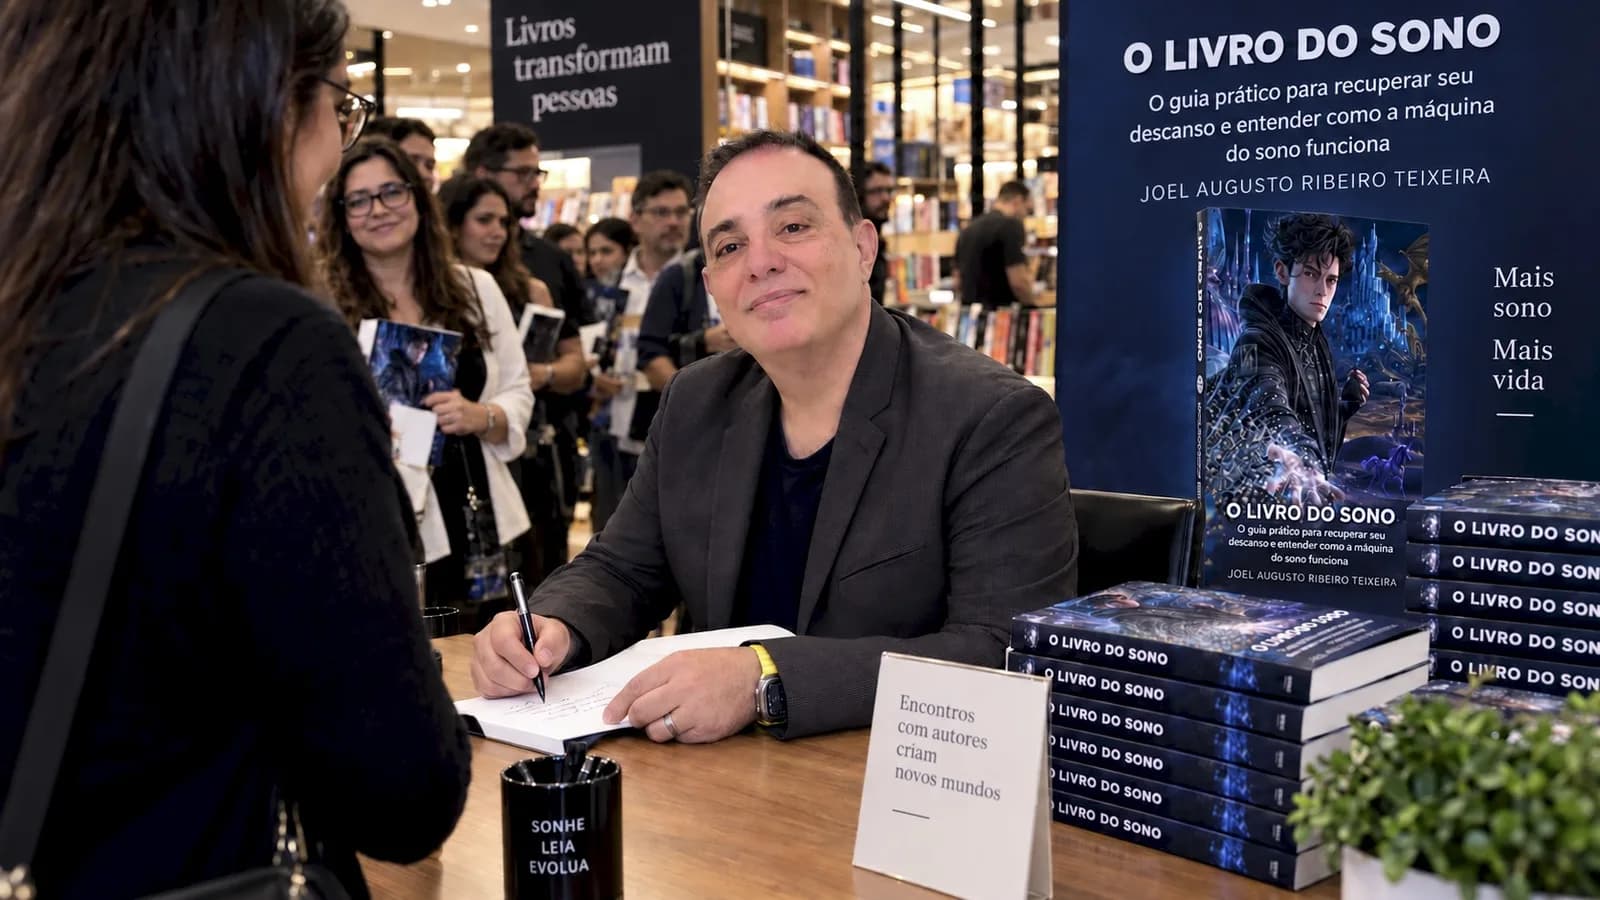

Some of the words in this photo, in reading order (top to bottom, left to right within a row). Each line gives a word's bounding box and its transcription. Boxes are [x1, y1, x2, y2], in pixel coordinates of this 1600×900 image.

[505, 15, 576, 47] Livros
[1123, 41, 1153, 74] O
[1164, 30, 1285, 71] LIVRO
[1297, 24, 1358, 61] DO
[1370, 13, 1501, 55] SONO
[513, 41, 670, 82] transformam
[532, 85, 618, 122] pessoas
[1149, 95, 1164, 112] O
[1170, 89, 1209, 114] guia
[1215, 84, 1281, 110] prático
[1286, 81, 1328, 104] para
[1334, 73, 1432, 96] recuperar
[1438, 70, 1473, 86] seu
[1129, 120, 1215, 143] descanso
[1220, 121, 1231, 135] e
[1236, 110, 1321, 133] entender
[1326, 106, 1381, 125] como
[1387, 106, 1398, 121] a
[1404, 97, 1494, 120] máquina
[1226, 143, 1249, 162] do
[1255, 142, 1300, 160] sono
[1305, 137, 1391, 157] funciona
[1140, 183, 1189, 202] JOEL
[1196, 176, 1294, 197] AUGUSTO
[1302, 171, 1386, 191] RIBEIRO
[1394, 168, 1491, 187] TEIXEIRA
[1494, 266, 1554, 288] Mais
[1494, 302, 1552, 317] sono
[1493, 339, 1553, 360] Mais
[1492, 369, 1544, 390] vida
[1226, 502, 1241, 519] O
[1246, 503, 1301, 521] LIVRO
[1307, 506, 1335, 522] DO
[1340, 507, 1395, 524] SONO
[1228, 537, 1269, 548] descanso
[1277, 539, 1318, 550] entender
[1319, 542, 1345, 551] como
[1354, 541, 1394, 554] máquina
[1237, 524, 1245, 533] O
[1247, 525, 1267, 537] guia
[1269, 525, 1300, 538] prático
[1302, 528, 1322, 538] para
[1324, 530, 1367, 541] recuperar
[1369, 532, 1386, 540] seu
[1454, 520, 1466, 533] O
[1472, 521, 1525, 539] LIVRO
[1531, 526, 1558, 540] DO
[1564, 528, 1600, 543] SON
[1271, 553, 1283, 563] do
[1308, 554, 1349, 566] funciona
[1452, 555, 1464, 568] O
[1471, 556, 1522, 573] LIVRO
[1528, 561, 1555, 576] DO
[1561, 564, 1600, 580] SON
[1227, 569, 1254, 580] JOEL
[1257, 571, 1305, 582] AUGUSTO
[1308, 573, 1349, 584] RIBEIRO
[1352, 576, 1397, 587] TEIXEIRA
[1452, 591, 1464, 603] O
[1470, 592, 1522, 609] LIVRO
[1529, 598, 1556, 613] DO
[1562, 601, 1600, 617] SON
[1049, 634, 1058, 646] O
[1062, 636, 1101, 653] LIVRO
[1105, 644, 1124, 657] DO
[1128, 648, 1168, 665] SONO
[1452, 626, 1464, 639] O
[1469, 628, 1522, 646] LIVRO
[1528, 634, 1556, 649] DO
[1562, 638, 1600, 655] SON
[1045, 668, 1054, 679] O
[1058, 670, 1096, 687] LIVRO
[1101, 678, 1120, 692] DO
[1124, 683, 1164, 701] SONO
[1451, 660, 1463, 673] O
[1527, 670, 1555, 685] DO
[1561, 674, 1600, 691] SON
[900, 694, 975, 723] Encontros
[1059, 704, 1097, 722] LIVRO
[1102, 713, 1120, 727] DO
[1124, 718, 1164, 736] SONO
[898, 721, 928, 738] com
[932, 728, 988, 750] autores
[897, 743, 937, 764] criam
[1060, 737, 1097, 755] LIVRO
[1102, 746, 1120, 760] DO
[1124, 752, 1164, 771] SONO
[895, 766, 937, 786] novos
[941, 776, 1001, 801] mundos
[1059, 769, 1097, 788] LIVRO
[1101, 780, 1120, 794] DO
[1123, 786, 1162, 805] SONO
[531, 818, 585, 833] SONHE
[1058, 802, 1096, 821] LIVRO
[1100, 813, 1119, 827] DO
[1123, 819, 1161, 840] SONO
[541, 840, 576, 855] LEIA
[529, 858, 589, 875] EVOLUA
